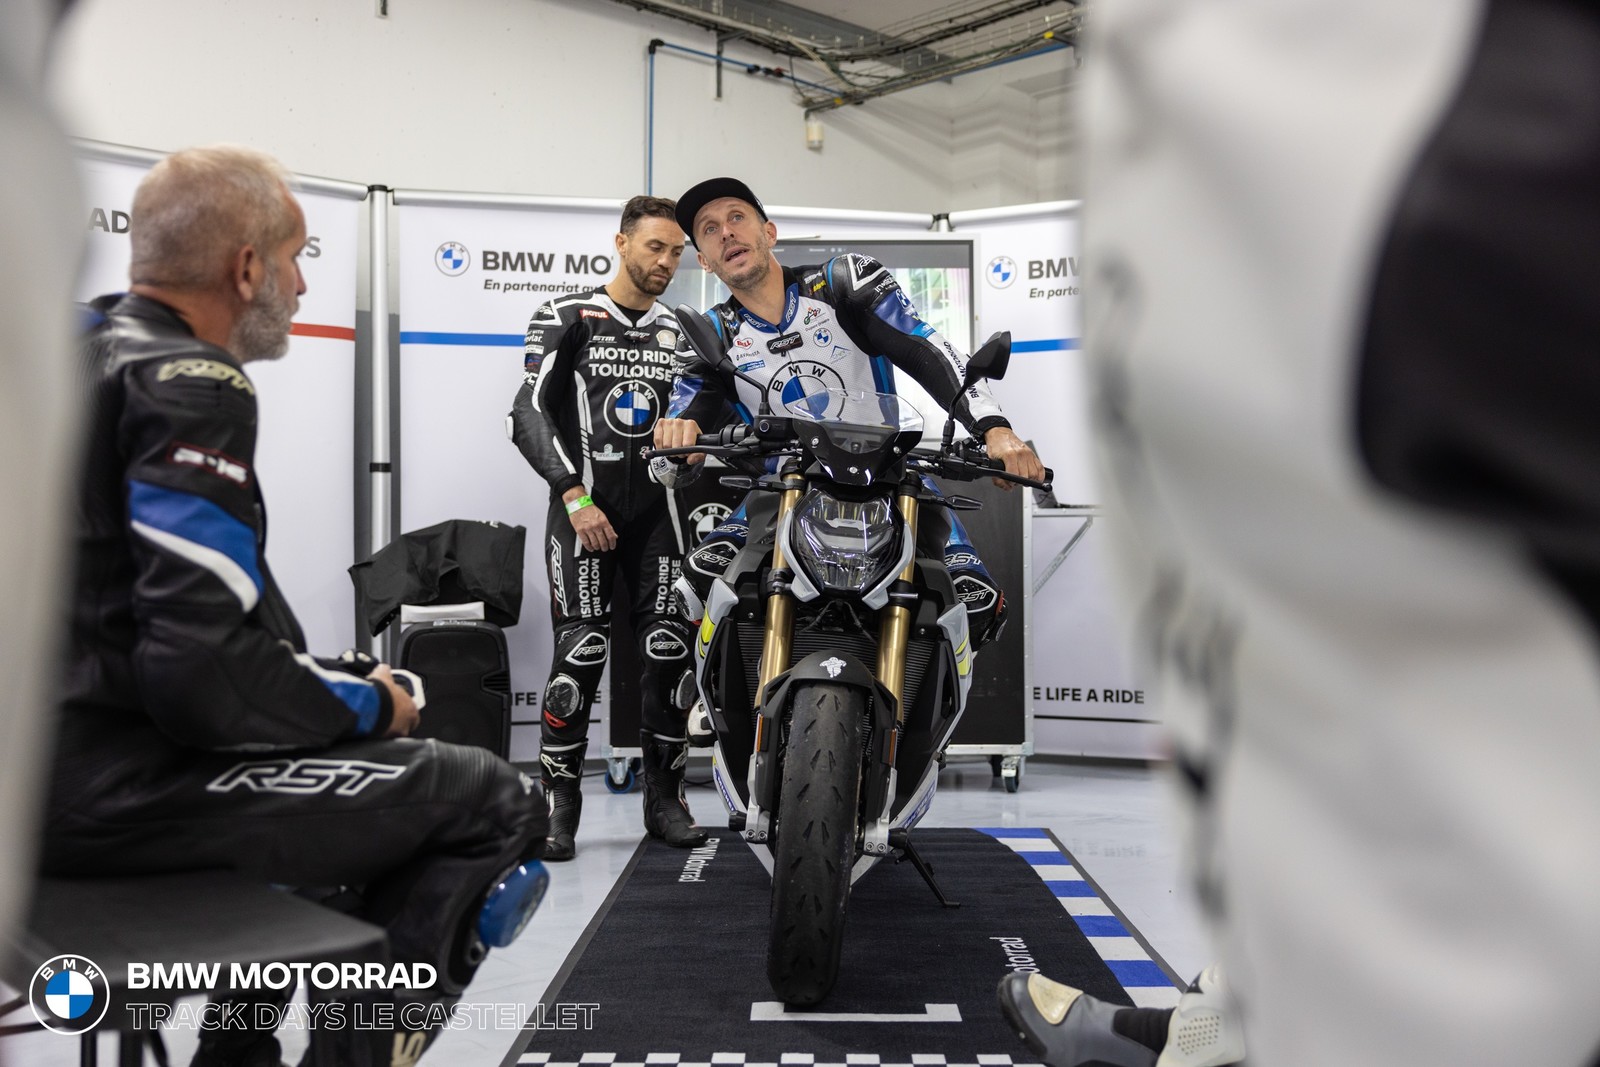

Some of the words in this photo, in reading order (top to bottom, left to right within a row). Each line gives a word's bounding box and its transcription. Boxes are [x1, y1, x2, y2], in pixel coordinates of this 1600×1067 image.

[482, 250, 555, 273] BMW
[565, 253, 614, 275] MO
[484, 279, 500, 290] En
[503, 282, 579, 294] partenariat
[1029, 288, 1044, 298] En
[582, 309, 608, 318] MOTUL
[770, 334, 800, 350] RST
[589, 347, 640, 362] MOTO
[642, 350, 678, 367] RIDE
[588, 363, 675, 383] TOULOUSE
[772, 365, 826, 392] BMW
[612, 382, 655, 400] BMW
[550, 535, 569, 617] RST
[590, 558, 600, 596] MOTO
[658, 556, 669, 584] RIDE
[574, 645, 606, 657] RST
[650, 641, 682, 650] RST
[510, 691, 537, 707] IFE
[1046, 687, 1082, 701] LIFE
[1087, 689, 1098, 702] A
[1103, 689, 1145, 704] RIDE
[206, 759, 407, 797] RST
